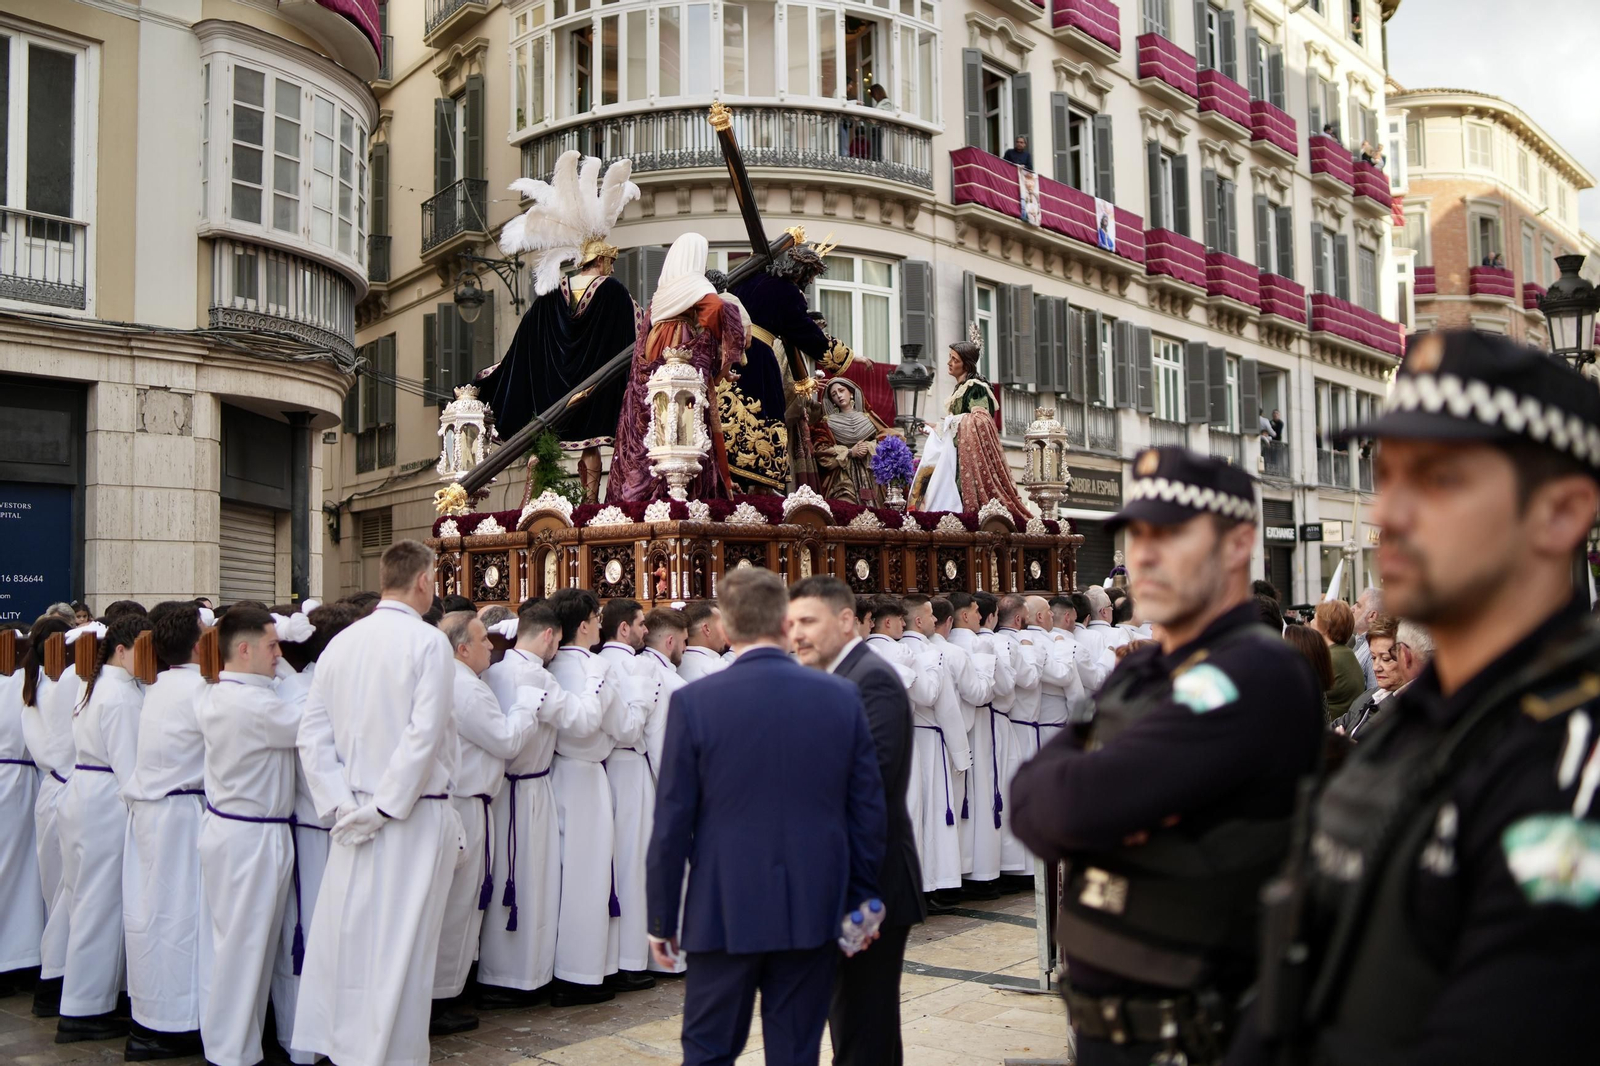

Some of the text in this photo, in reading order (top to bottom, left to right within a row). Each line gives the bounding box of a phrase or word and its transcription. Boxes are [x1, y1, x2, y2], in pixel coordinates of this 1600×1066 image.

[1070, 477, 1119, 497] SABOR A ESPAÑA
[0, 511, 22, 519] PITAL
[1266, 527, 1295, 539] EXCHANGE
[1, 574, 44, 583] 16 836644
